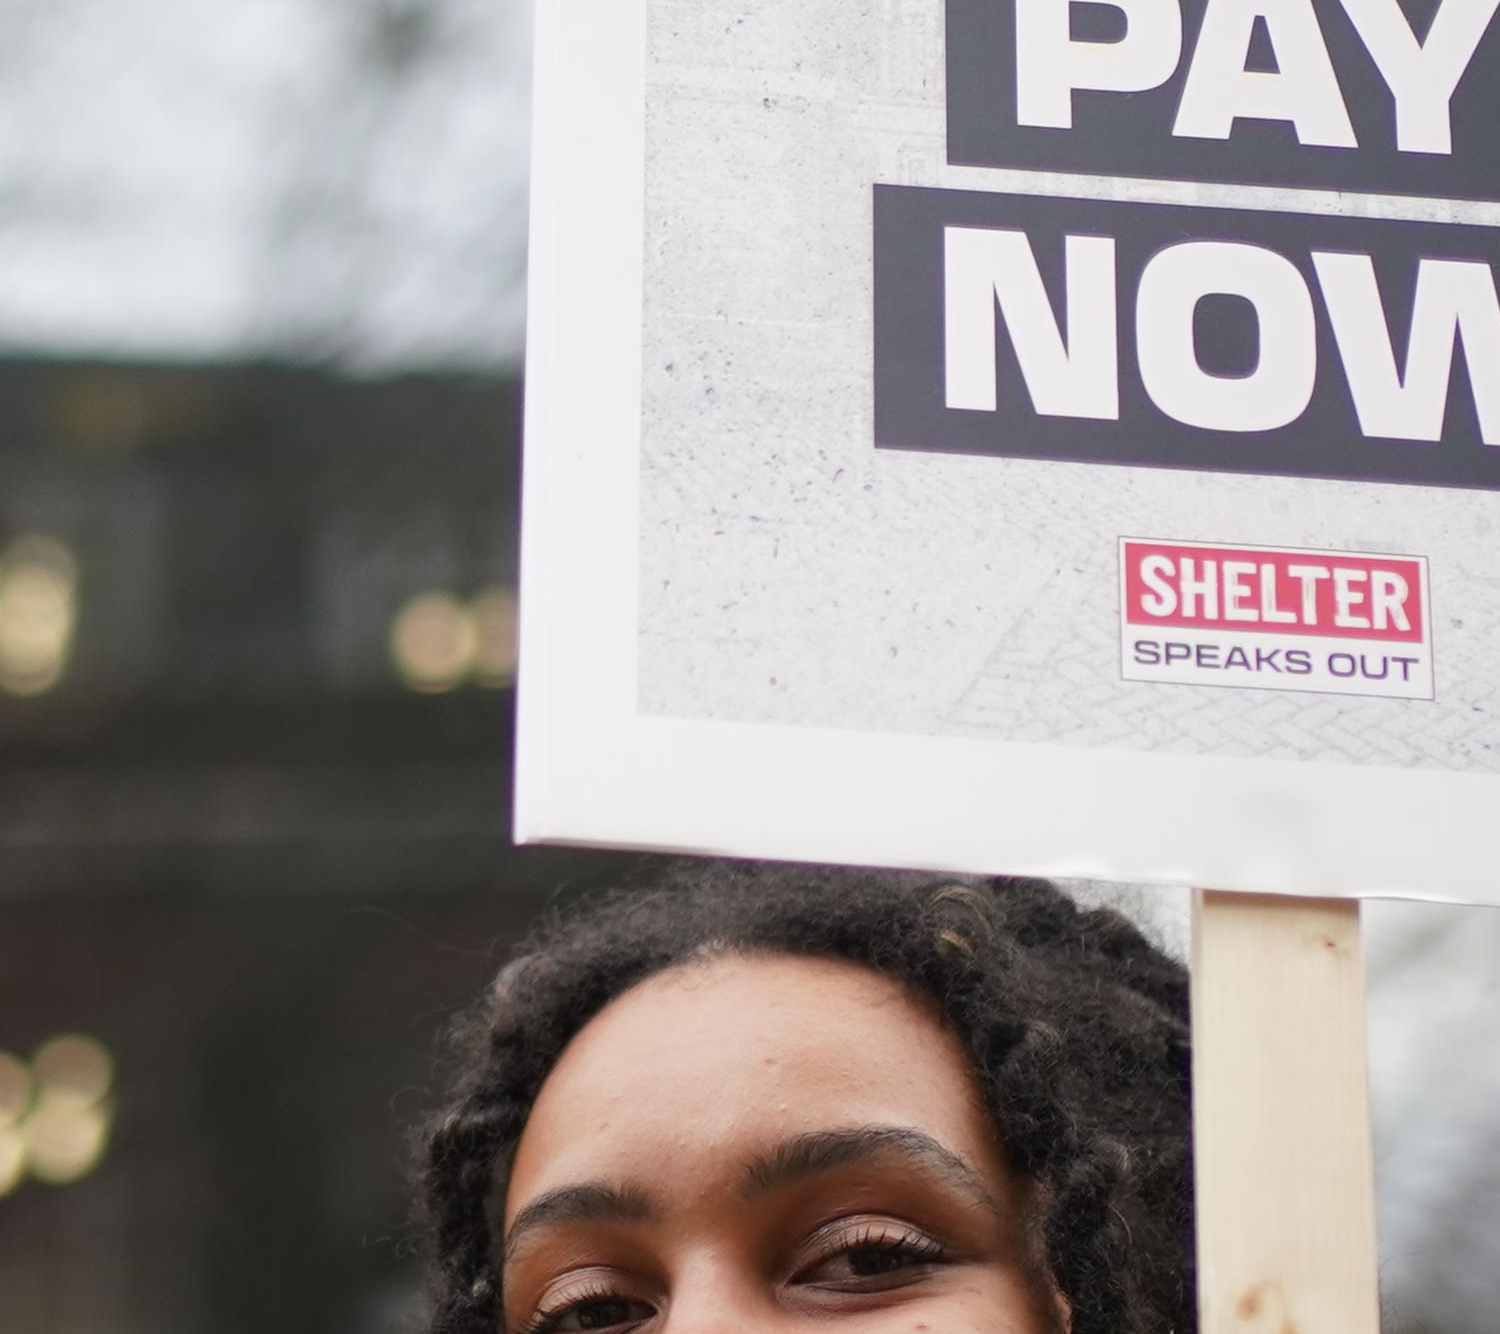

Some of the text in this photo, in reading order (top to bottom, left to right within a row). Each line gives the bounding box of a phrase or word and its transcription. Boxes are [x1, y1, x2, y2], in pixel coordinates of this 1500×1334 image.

[1139, 554, 1412, 632] SHELTER
[1133, 639, 1420, 682] SPEAKS OUT
